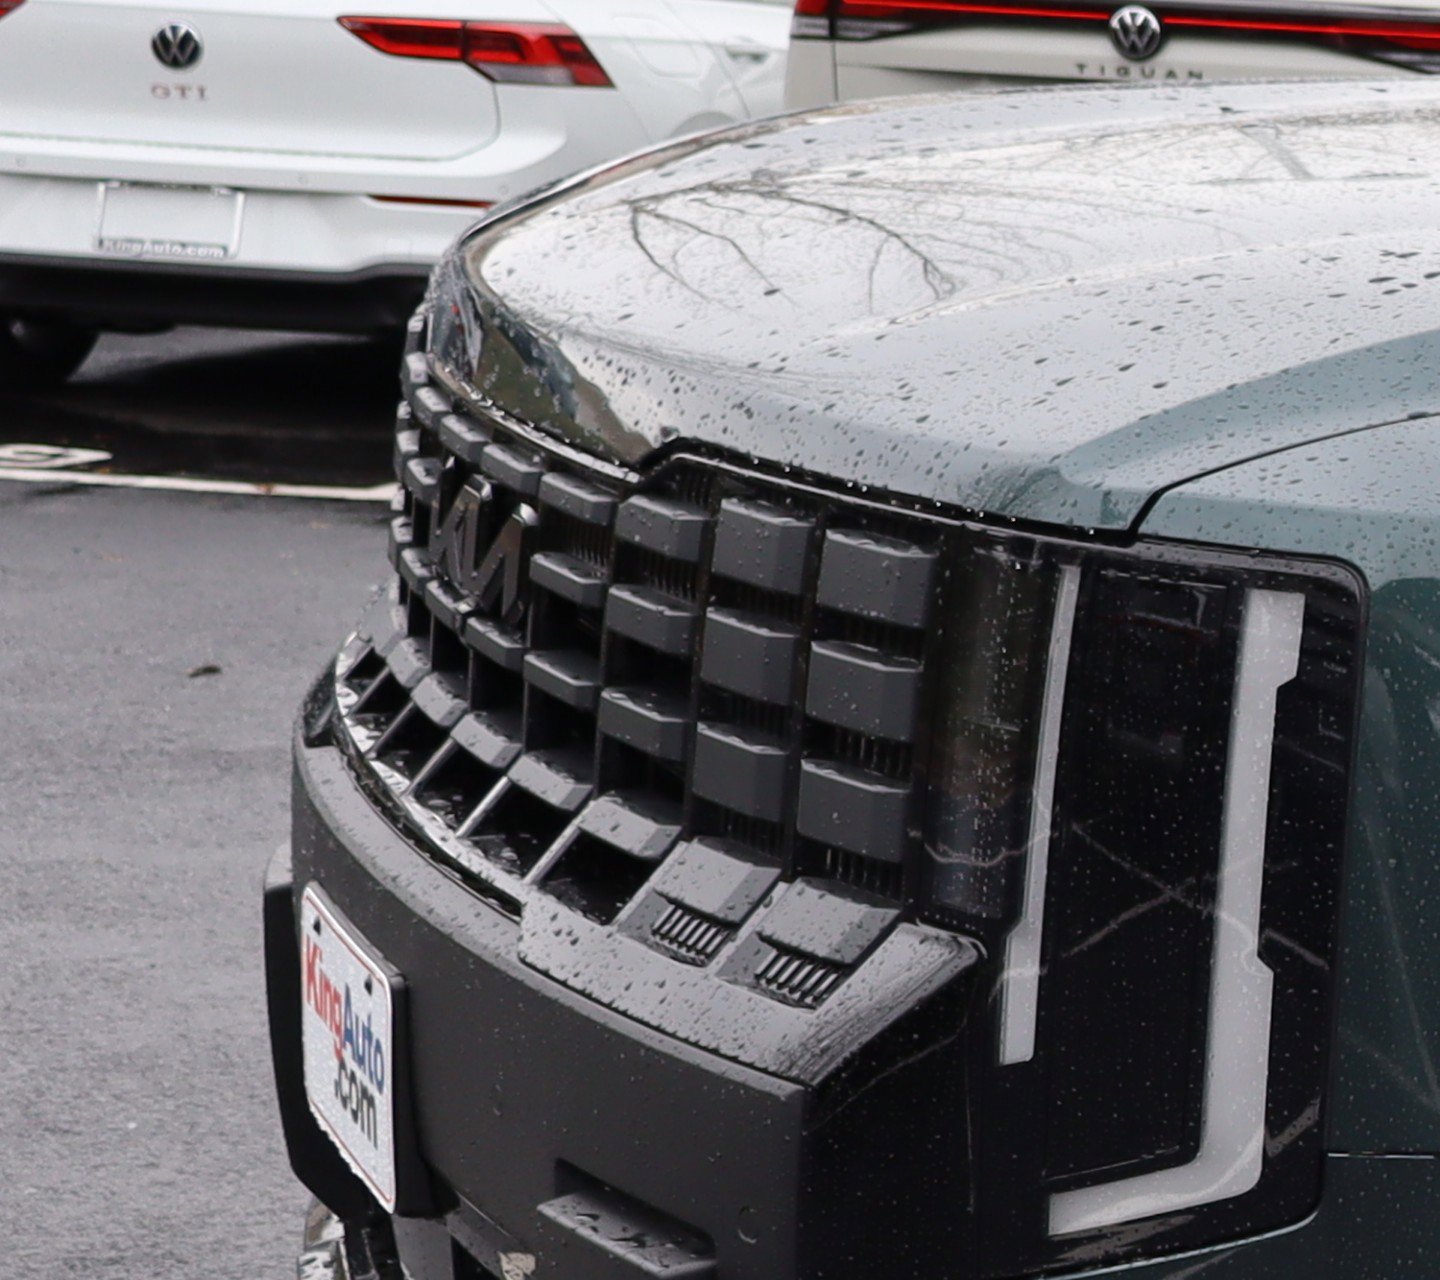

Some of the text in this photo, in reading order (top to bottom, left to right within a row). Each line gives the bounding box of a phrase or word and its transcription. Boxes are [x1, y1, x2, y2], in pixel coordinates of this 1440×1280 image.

[1076, 63, 1204, 80] TIGUAN
[151, 82, 208, 101] GTI
[103, 238, 225, 258] KingAuto.com
[305, 932, 386, 1096] KingAuto
[334, 1060, 378, 1151] .com
